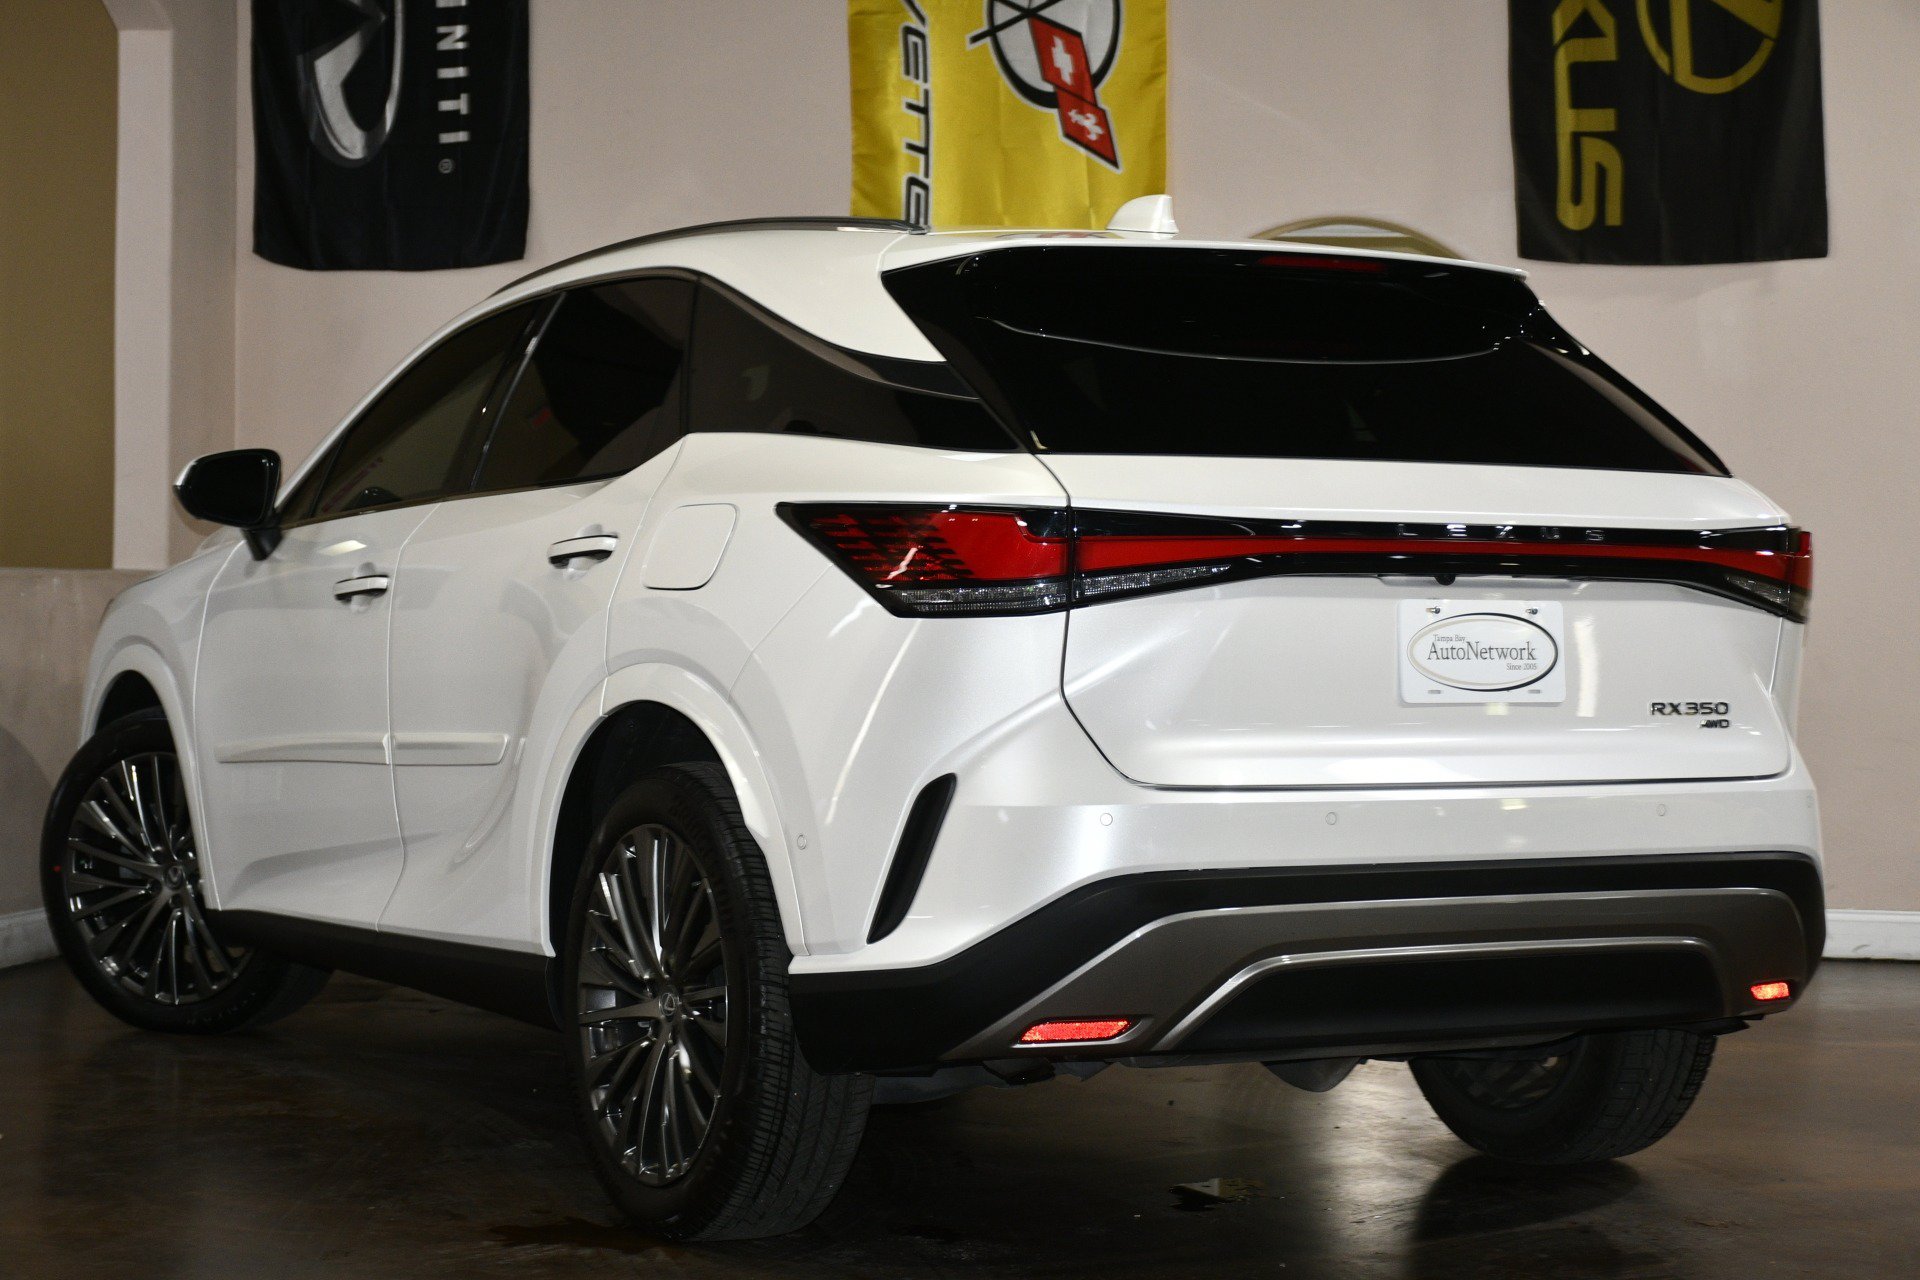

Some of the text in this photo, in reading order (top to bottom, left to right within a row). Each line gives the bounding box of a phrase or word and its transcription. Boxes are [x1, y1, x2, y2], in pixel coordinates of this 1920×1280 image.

[1398, 523, 1604, 541] LEXUS
[1433, 634, 1466, 643] Tampa Bay
[1427, 641, 1537, 661] AutoNetwork
[1700, 718, 1730, 729] AWD
